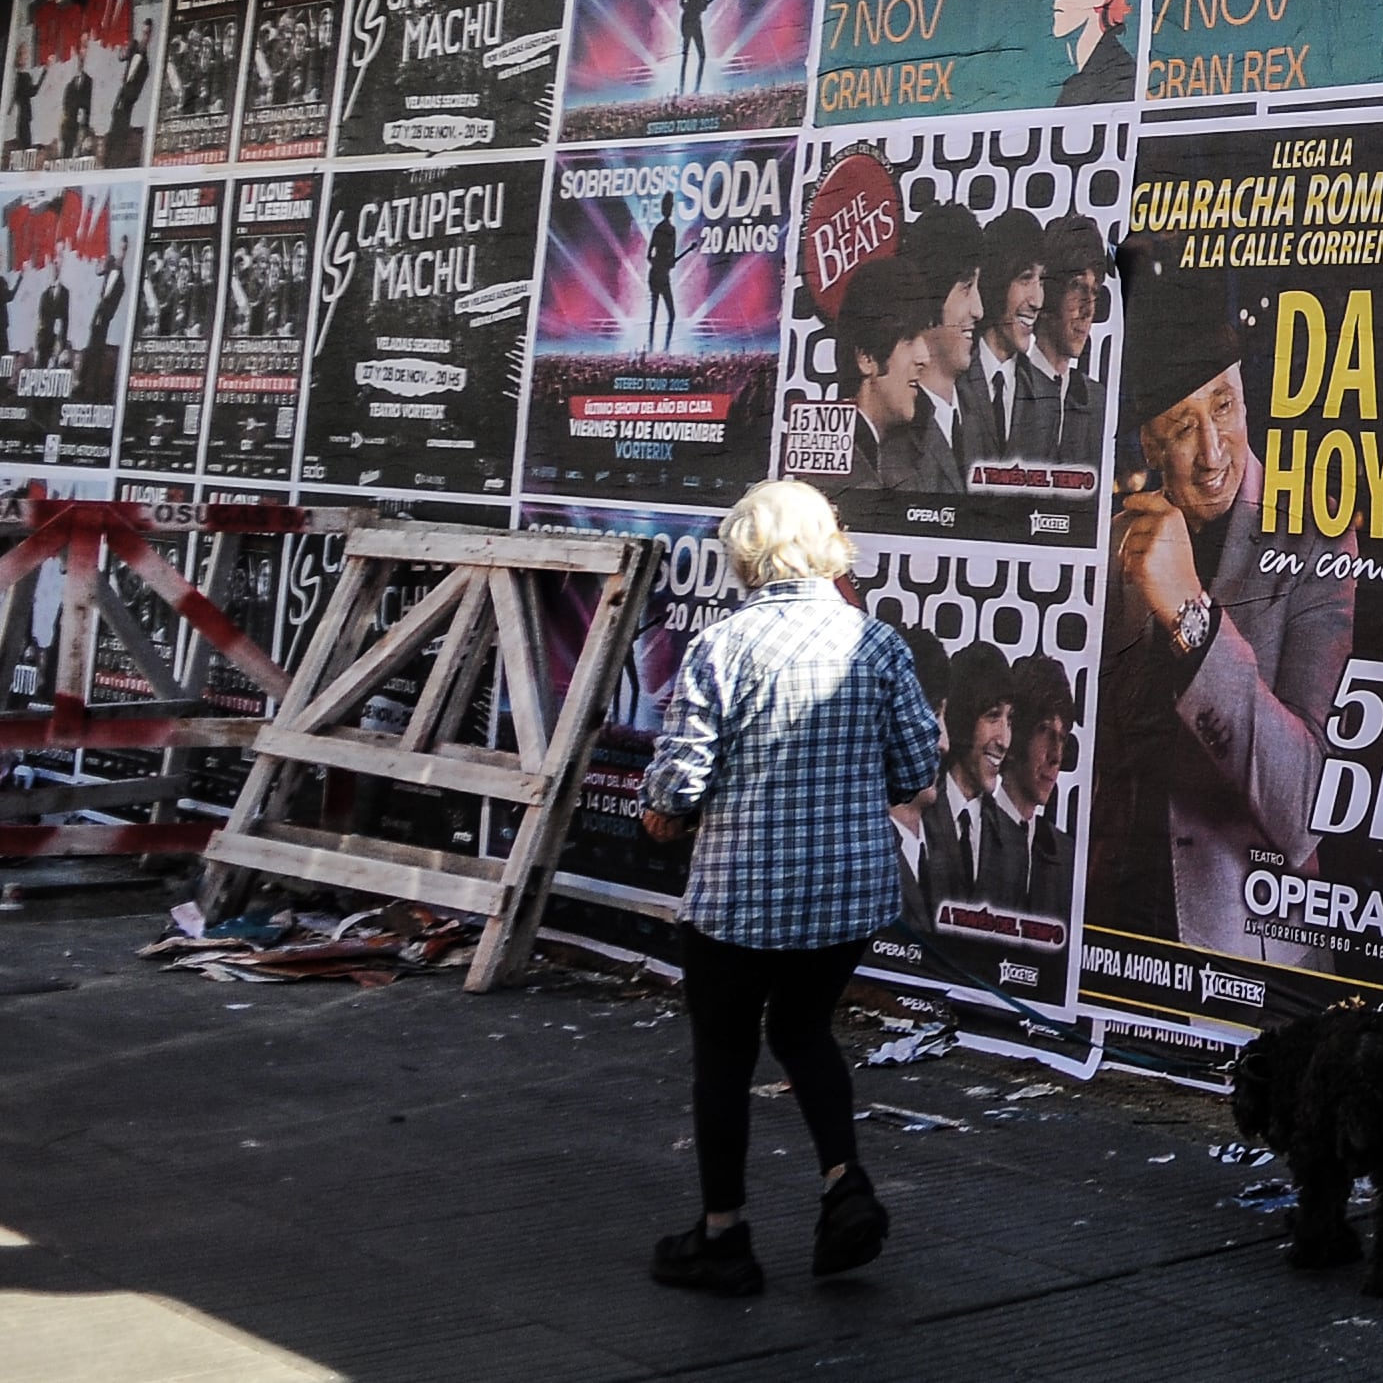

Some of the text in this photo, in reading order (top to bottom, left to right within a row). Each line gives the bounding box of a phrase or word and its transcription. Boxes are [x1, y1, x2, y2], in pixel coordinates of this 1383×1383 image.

[402, 0, 505, 63] MACHU
[829, 3, 848, 51] 7
[820, 60, 955, 113] GRAN REX
[1272, 138, 1353, 169] LLEGA LA
[560, 165, 680, 200] SOBREDOSIS
[679, 158, 781, 220] SODA
[1130, 175, 1297, 232] GUARACHA
[357, 182, 504, 249] CATUPECU
[831, 190, 868, 237] THE
[701, 219, 779, 254] 20 AÑOS
[811, 199, 896, 294] BEATS
[1180, 235, 1196, 268] A
[1200, 234, 1228, 267] LA
[1230, 232, 1291, 266] CALLE
[373, 245, 476, 302] MACHU
[569, 419, 725, 442] VIERNES 14 DE NOVIEMBRE
[790, 407, 855, 434] 15 NOV
[615, 441, 674, 460] VORTERIX
[787, 450, 849, 472] OPERA
[789, 432, 852, 452] TEATRO
[1259, 547, 1305, 576] en
[1264, 923, 1327, 949] CORRIENTES
[1329, 936, 1352, 952] 860
[1124, 952, 1172, 988] AHORA
[1173, 965, 1192, 992] EN
[1199, 962, 1265, 1008] TICKETEK
